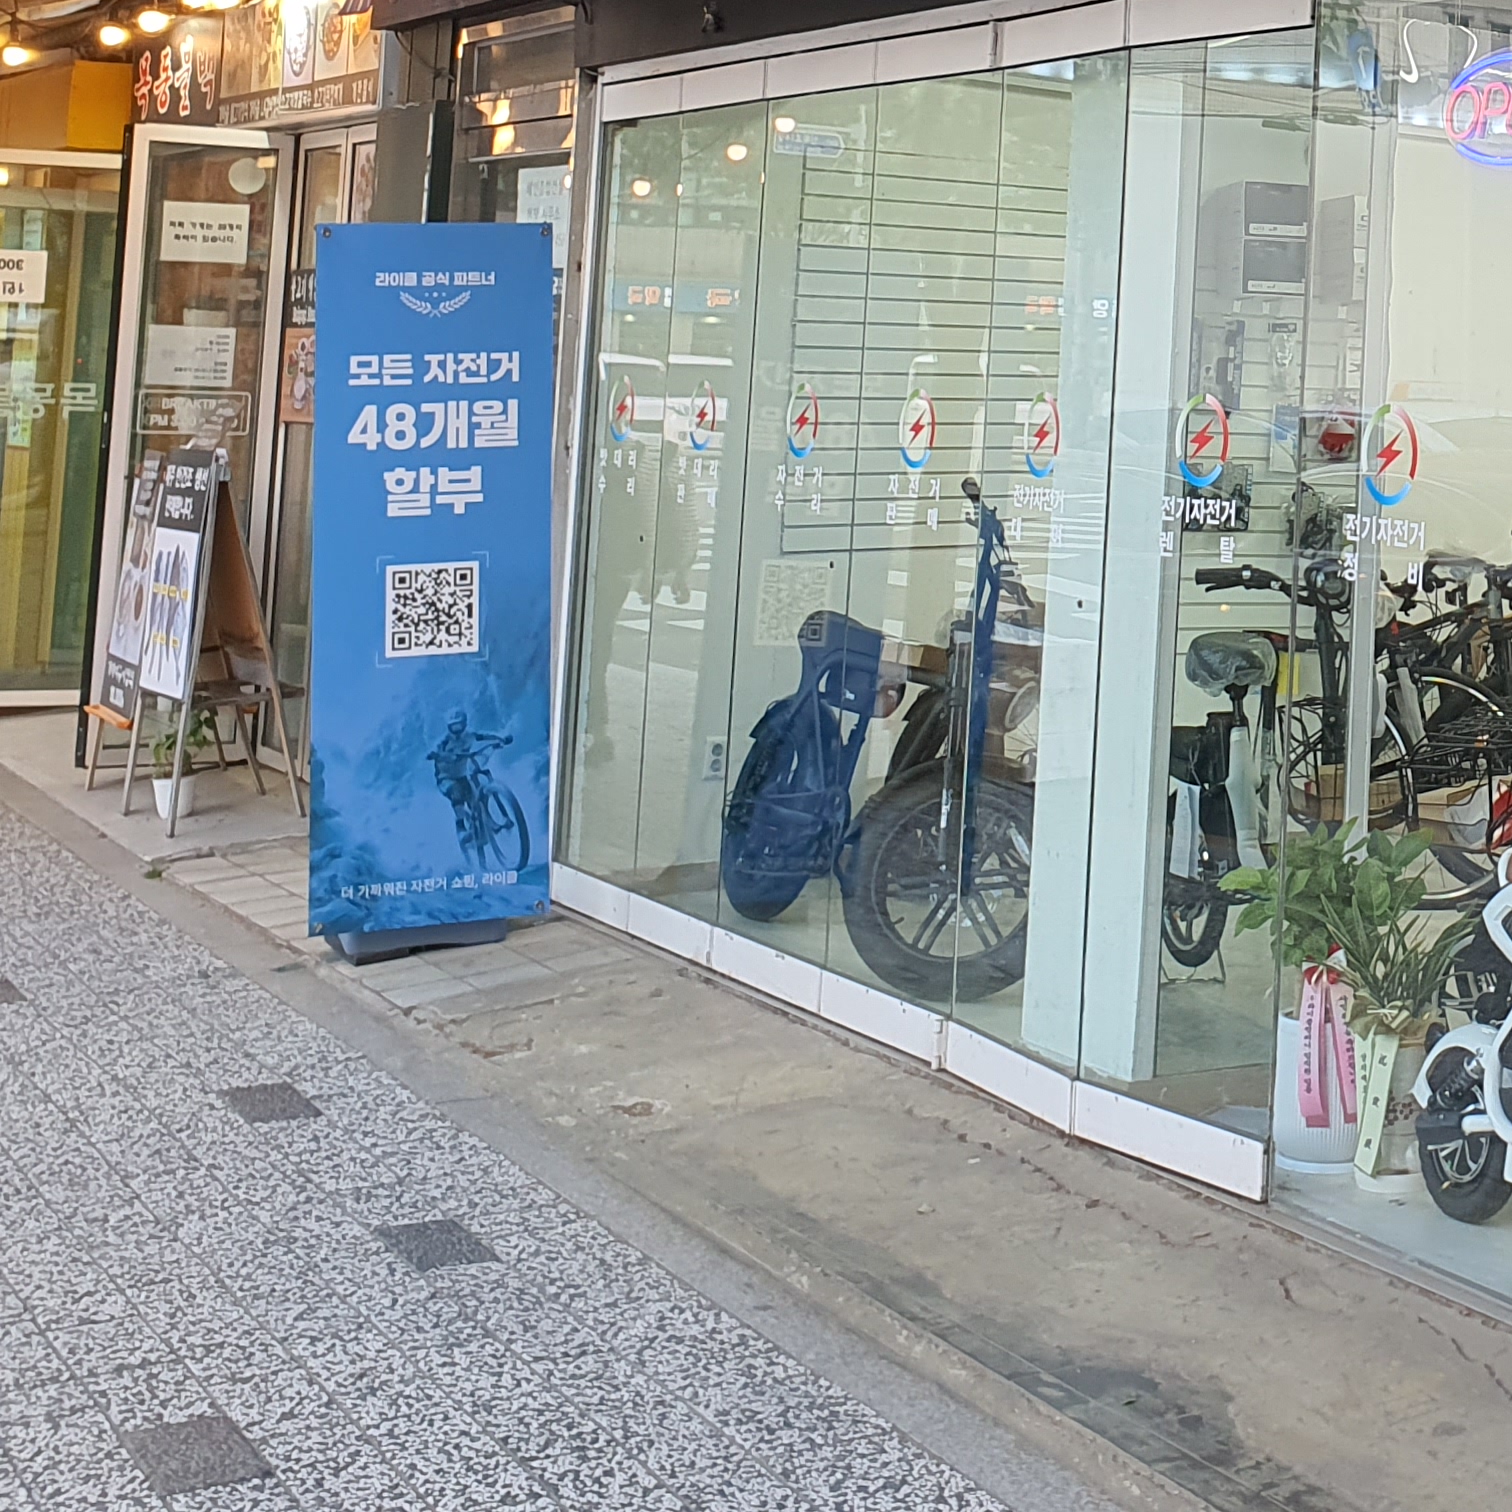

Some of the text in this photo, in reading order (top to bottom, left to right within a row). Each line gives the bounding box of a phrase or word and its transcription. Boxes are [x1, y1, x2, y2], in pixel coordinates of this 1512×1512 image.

[422, 271, 450, 286] 공식
[453, 271, 496, 286] 파트너
[348, 351, 520, 386] 모든 자전거
[347, 398, 520, 451] 48개월
[383, 465, 484, 518] 할부
[1013, 483, 1065, 513] 전기자전거
[1160, 494, 1237, 527] 전기자전거
[1343, 512, 1426, 551] 전기자전거
[340, 886, 354, 900] 더
[410, 876, 448, 894] 자전거
